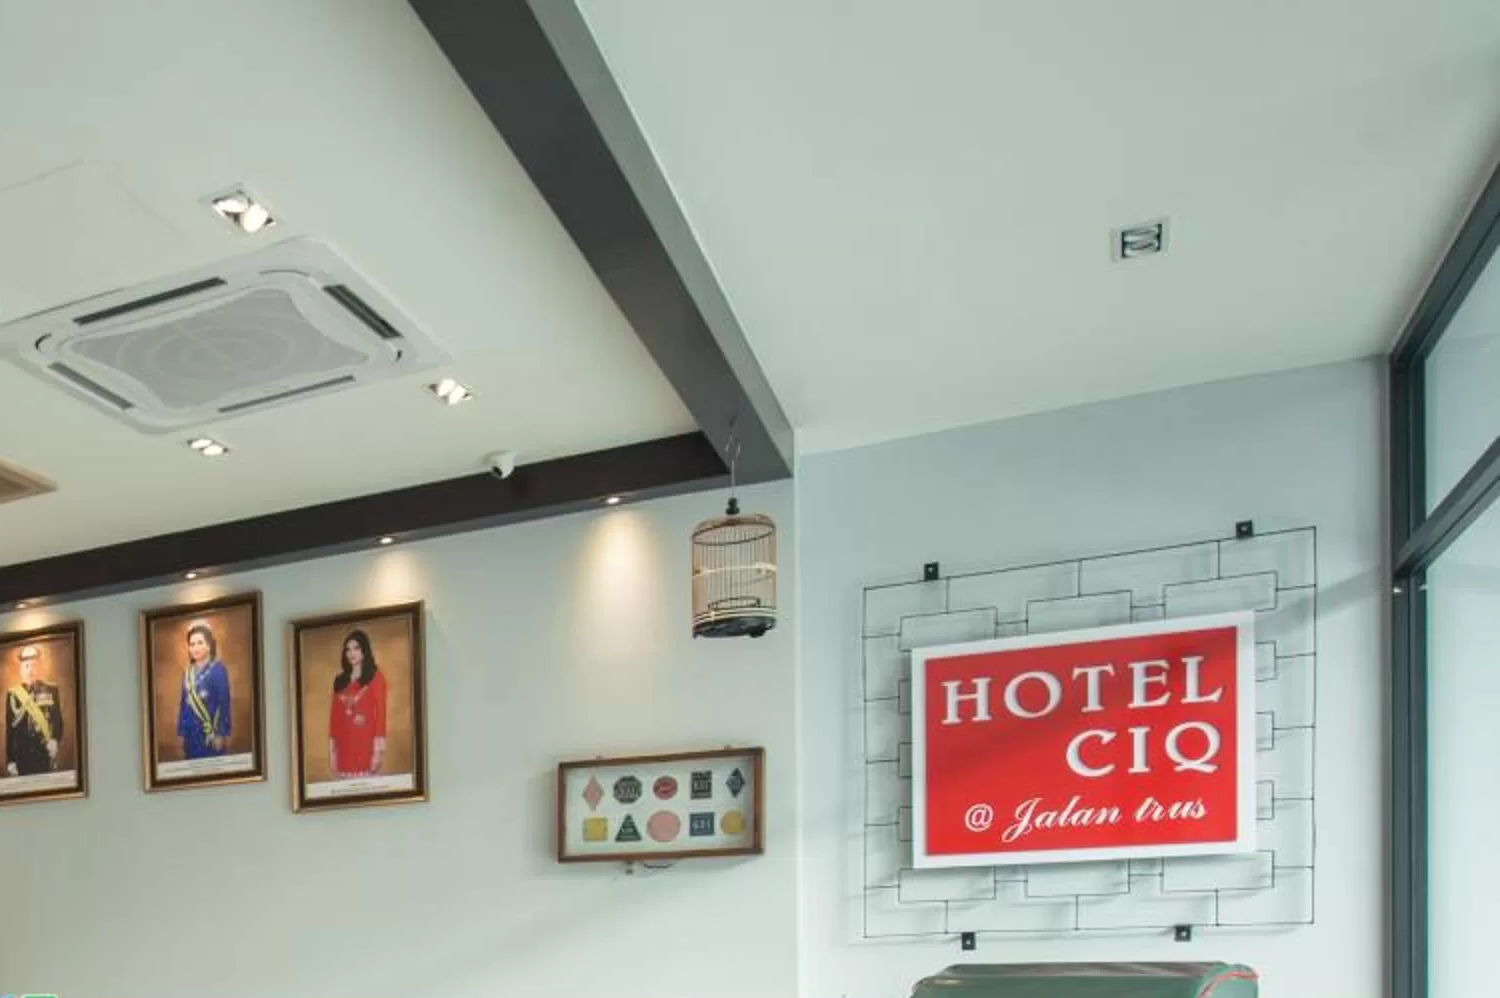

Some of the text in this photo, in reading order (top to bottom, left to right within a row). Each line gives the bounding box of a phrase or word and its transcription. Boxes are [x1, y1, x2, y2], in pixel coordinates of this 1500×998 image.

[941, 655, 1223, 724] HOTEL
[1065, 721, 1221, 777] CIQ
[965, 803, 994, 832] @
[1002, 795, 1122, 843] Jalan
